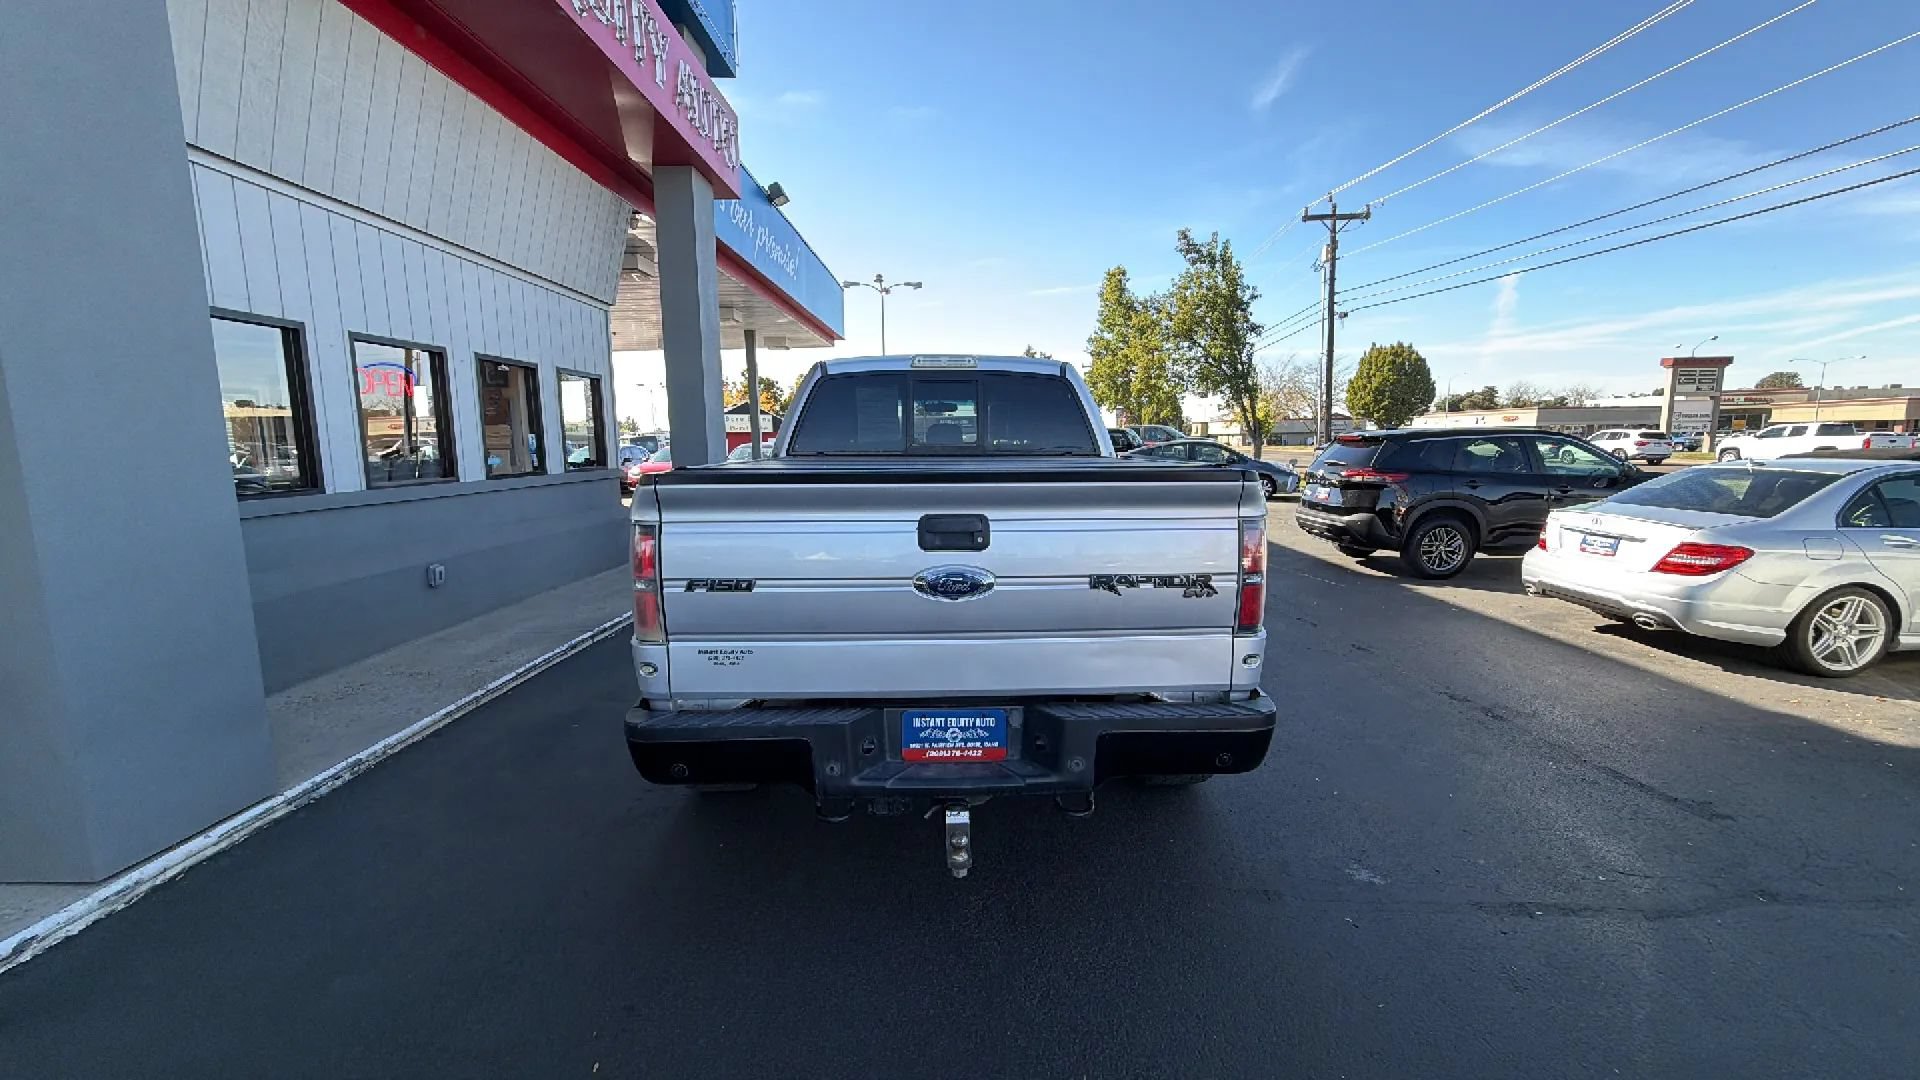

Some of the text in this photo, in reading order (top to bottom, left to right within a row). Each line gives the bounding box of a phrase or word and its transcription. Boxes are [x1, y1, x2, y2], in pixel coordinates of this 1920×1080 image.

[1089, 574, 1217, 596] RAPTOR
[912, 717, 996, 728] INSTANT EQUITY AUTO
